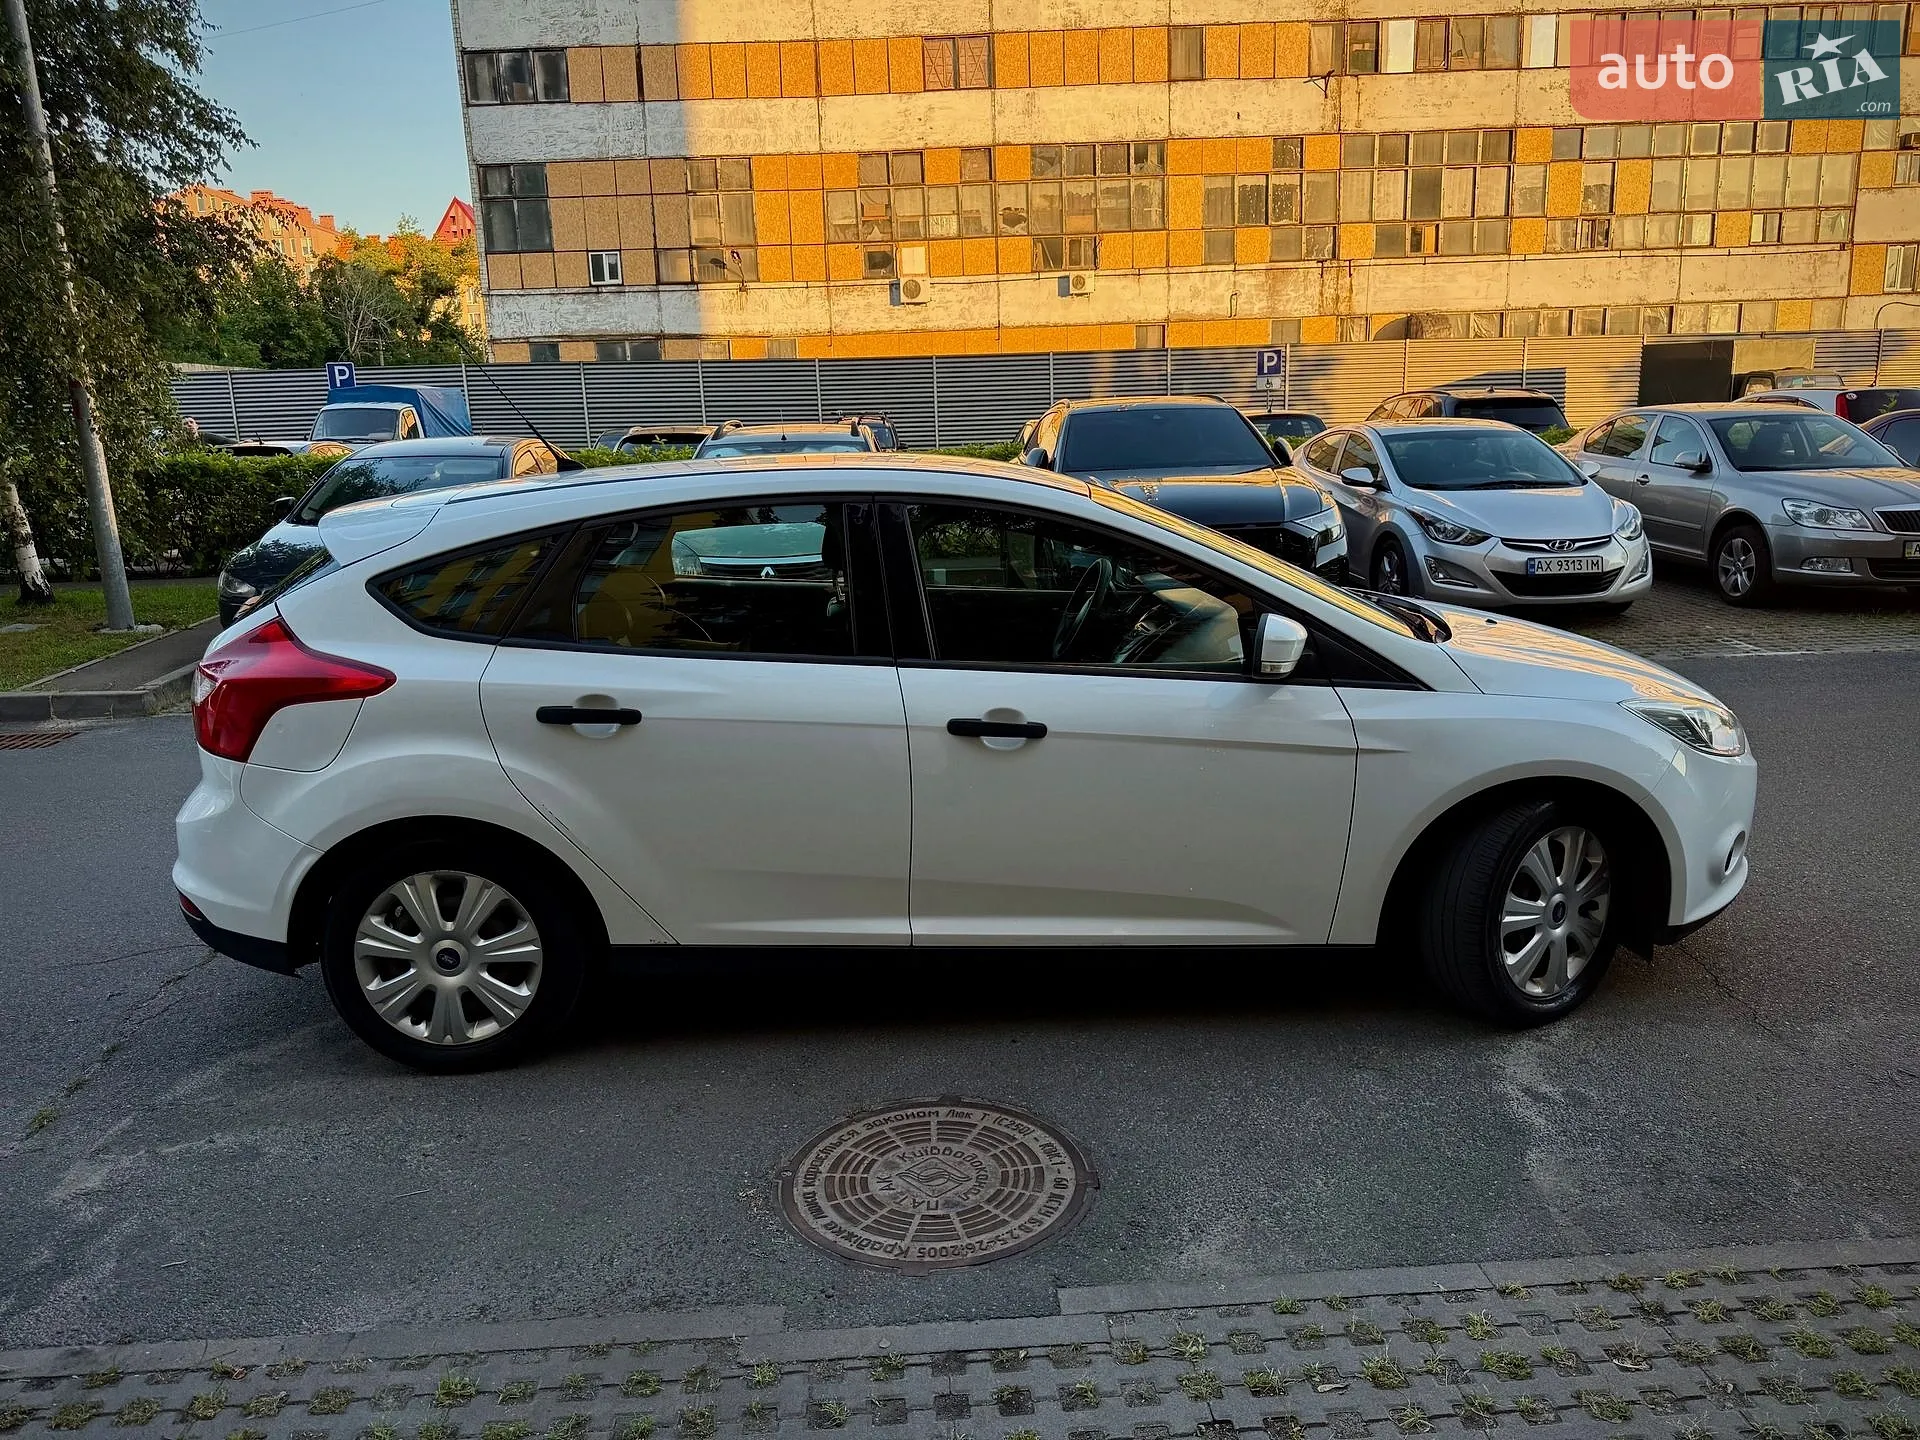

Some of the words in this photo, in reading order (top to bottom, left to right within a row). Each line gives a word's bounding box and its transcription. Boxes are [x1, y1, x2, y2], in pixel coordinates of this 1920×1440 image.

[1264, 353, 1277, 373] P
[334, 366, 350, 387] P
[1536, 560, 1552, 572] AX
[1557, 560, 1583, 571] 9313
[1586, 560, 1599, 571] IM
[863, 1110, 939, 1131] законом
[822, 1220, 910, 1259] Крадіжка
